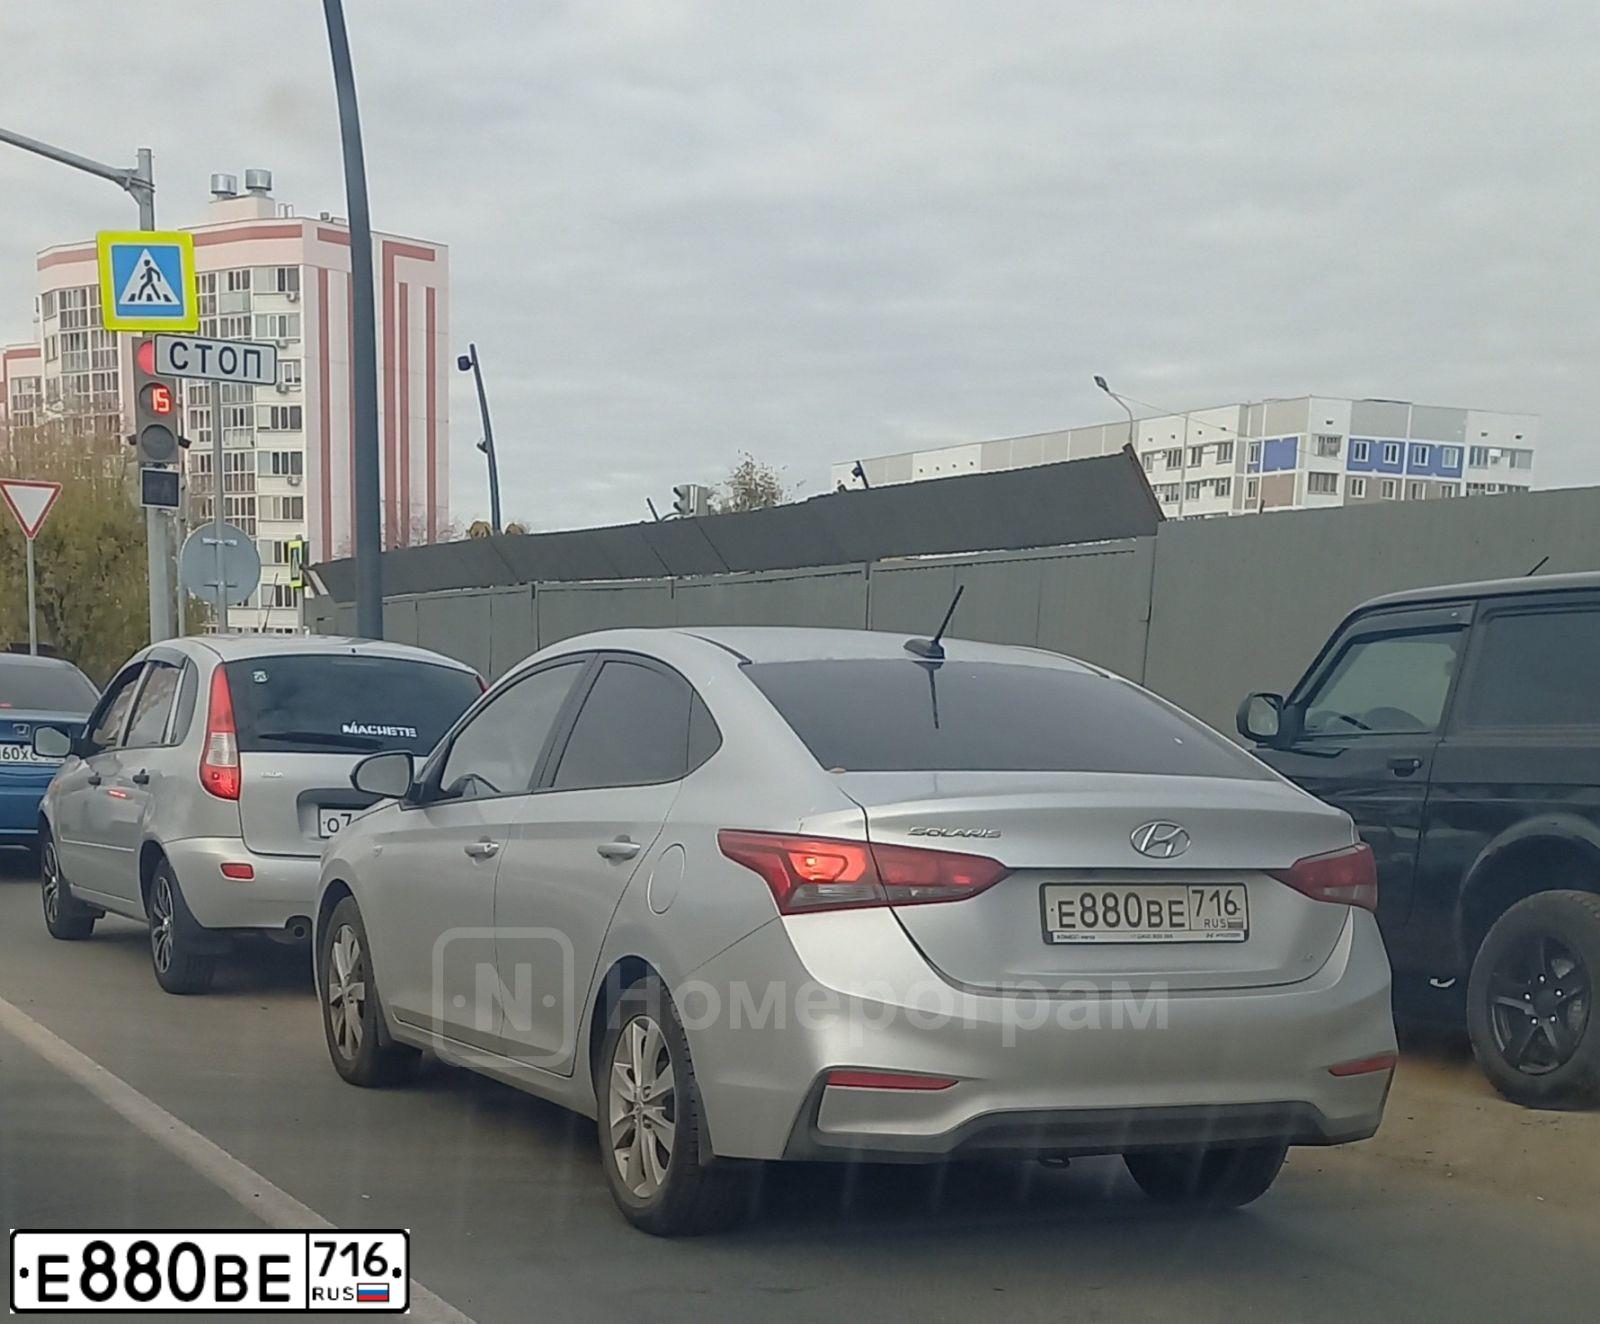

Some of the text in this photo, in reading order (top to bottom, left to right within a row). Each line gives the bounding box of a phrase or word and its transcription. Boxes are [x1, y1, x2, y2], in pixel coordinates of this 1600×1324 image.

[169, 341, 261, 379] СТОП
[152, 387, 171, 413] 15
[0, 746, 38, 761] 60ХС
[327, 813, 352, 833] О7
[907, 826, 1002, 839] SOLARIS
[1057, 889, 1237, 929] Е880ВЕ 716
[1204, 919, 1227, 929] RUS
